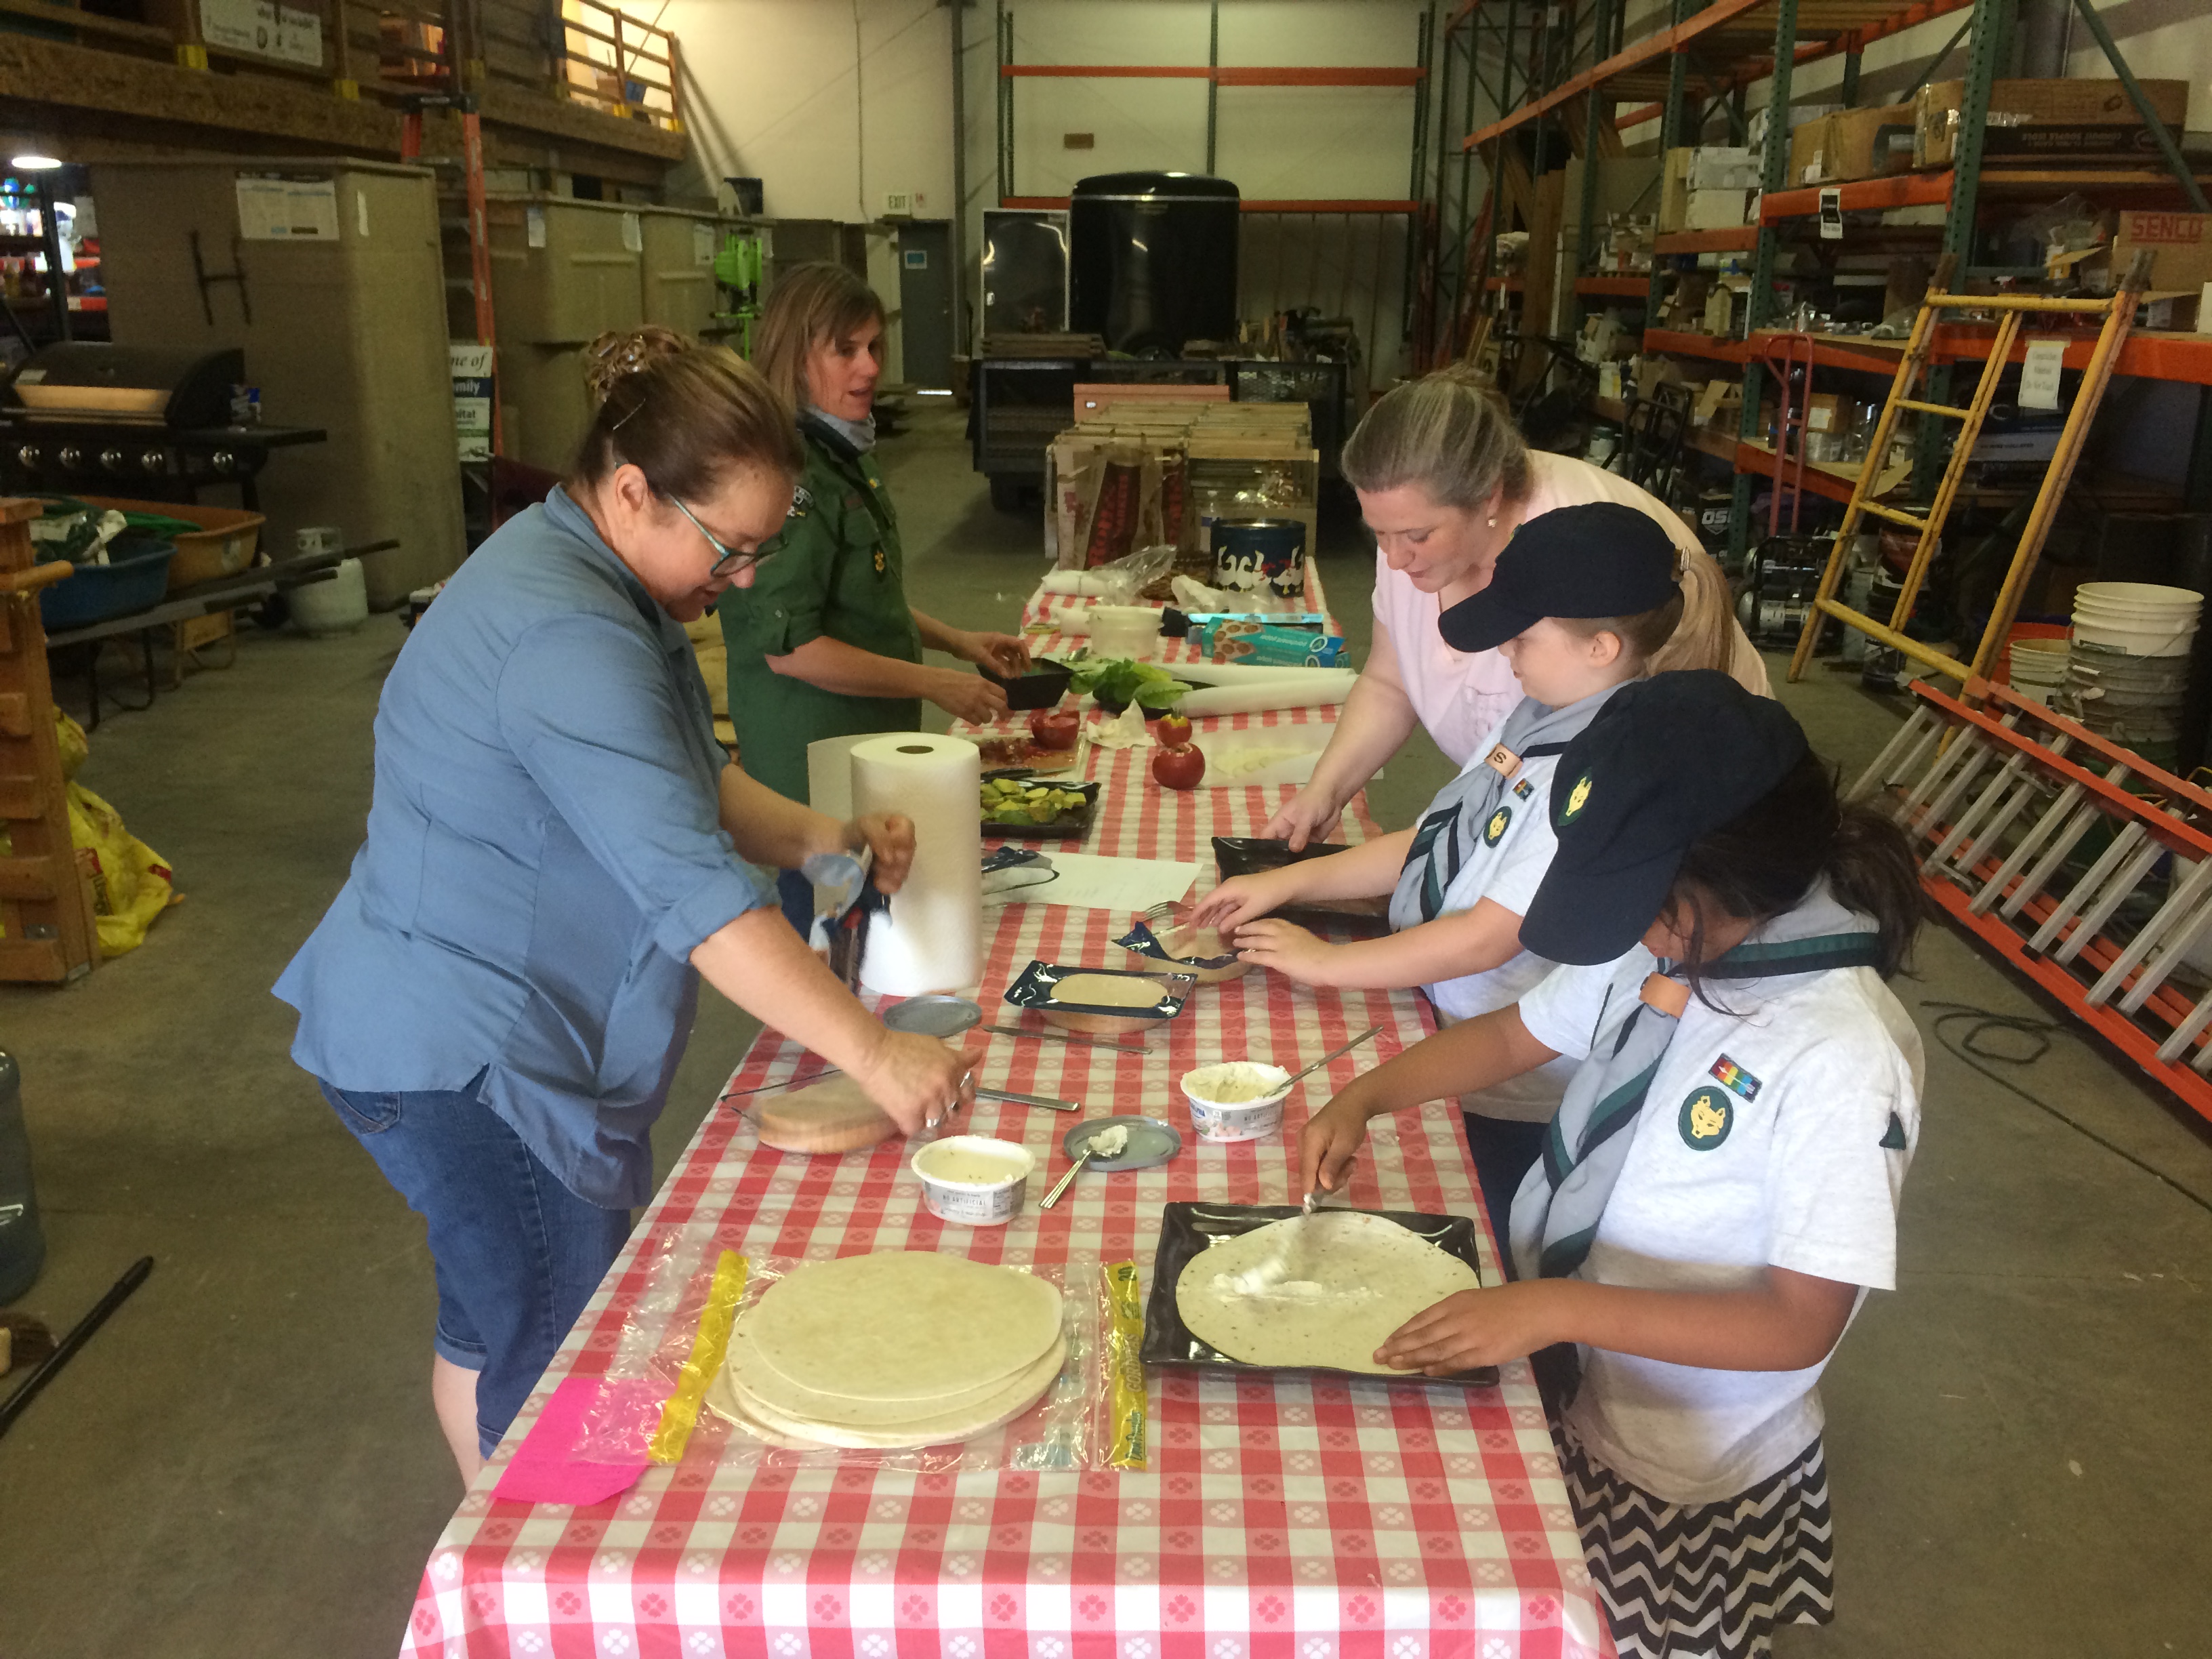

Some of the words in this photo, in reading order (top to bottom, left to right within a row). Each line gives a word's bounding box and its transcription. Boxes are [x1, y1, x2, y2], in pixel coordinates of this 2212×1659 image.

[888, 194, 907, 209] EXIT
[2131, 215, 2204, 239] SENCO
[471, 351, 488, 371] of
[454, 380, 480, 396] mily
[952, 1196, 986, 1206] ARTIFICIAL
